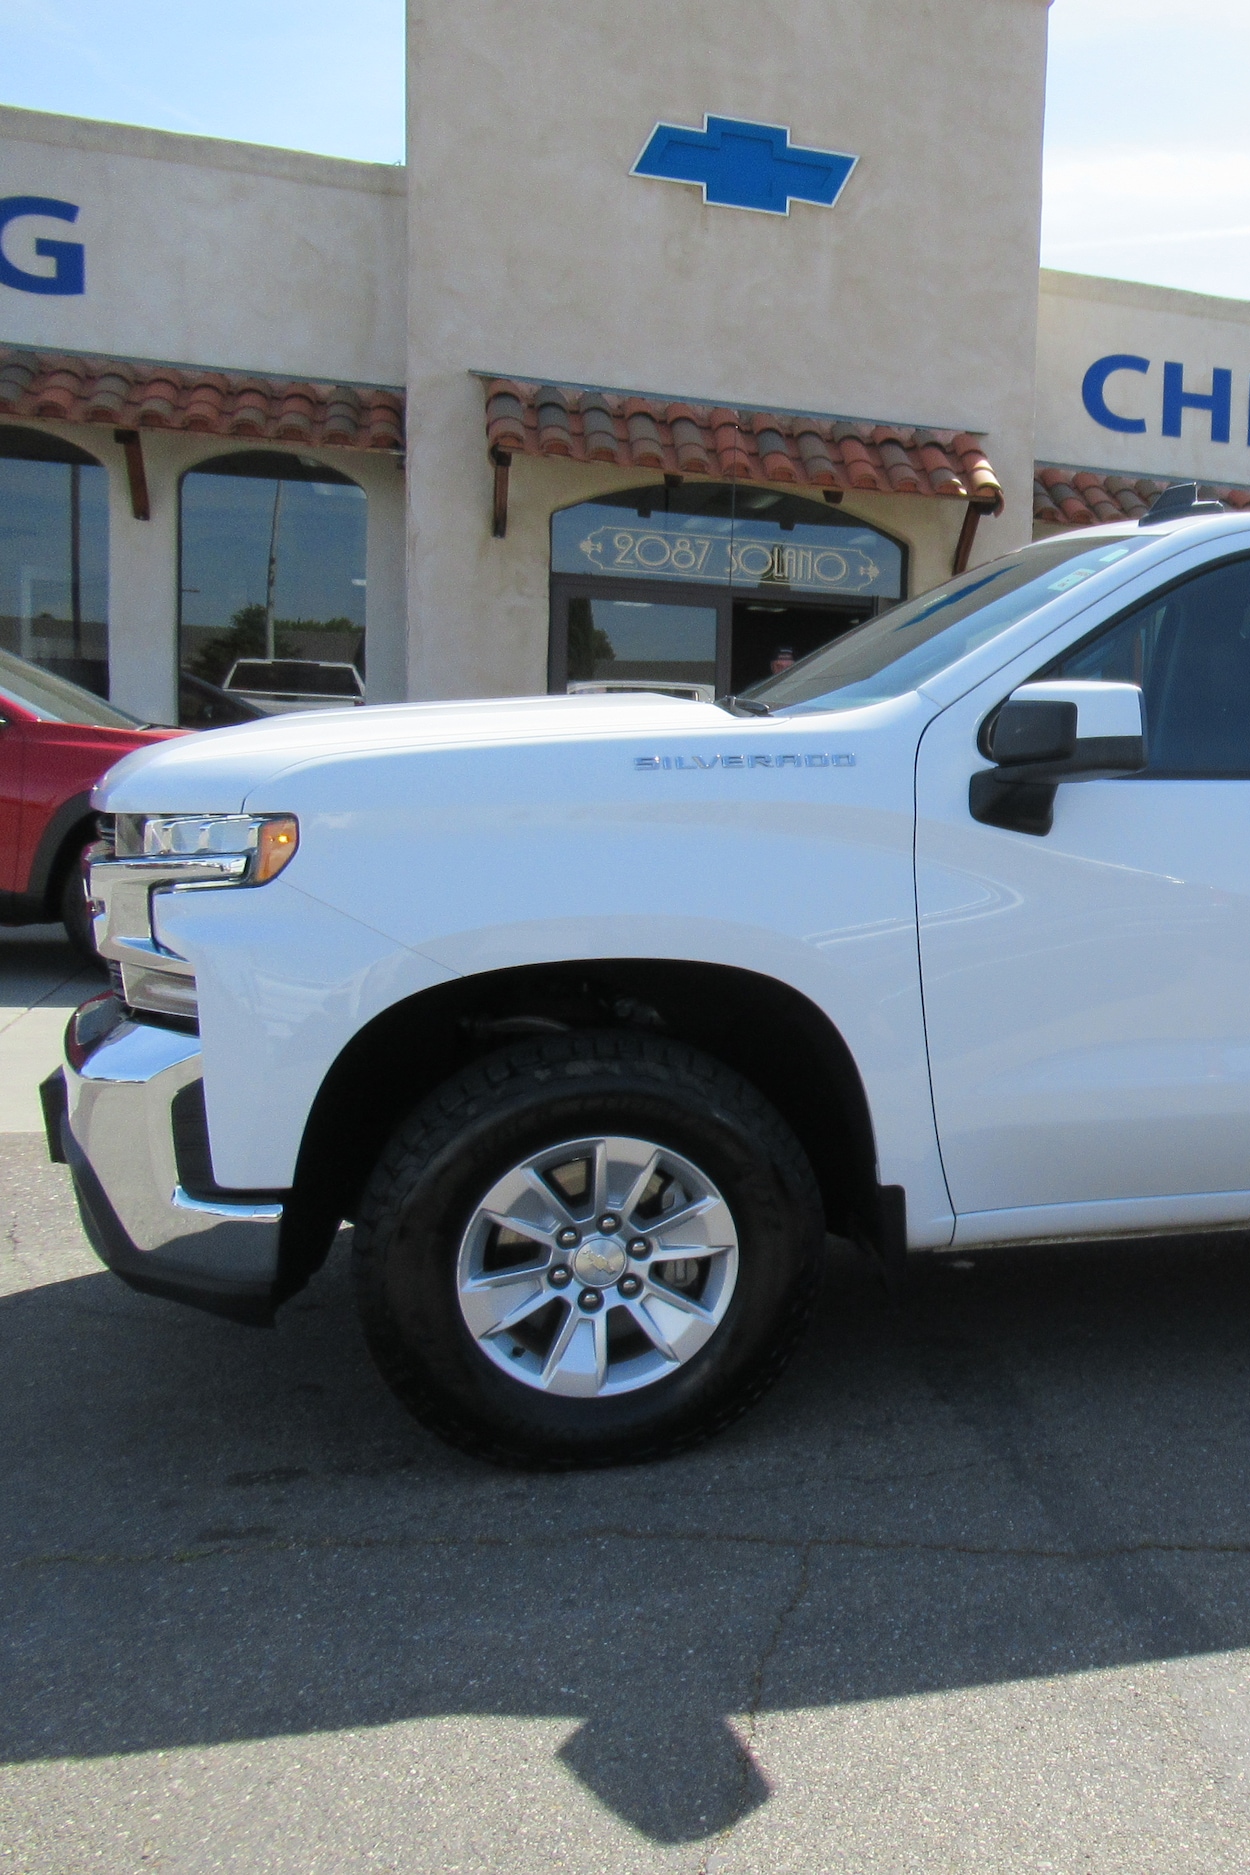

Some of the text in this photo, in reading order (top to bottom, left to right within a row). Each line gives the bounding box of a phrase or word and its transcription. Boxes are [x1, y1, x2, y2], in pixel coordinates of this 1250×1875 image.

[612, 532, 850, 587] 2087 SOLANO
[633, 752, 857, 771] SILVERADO
